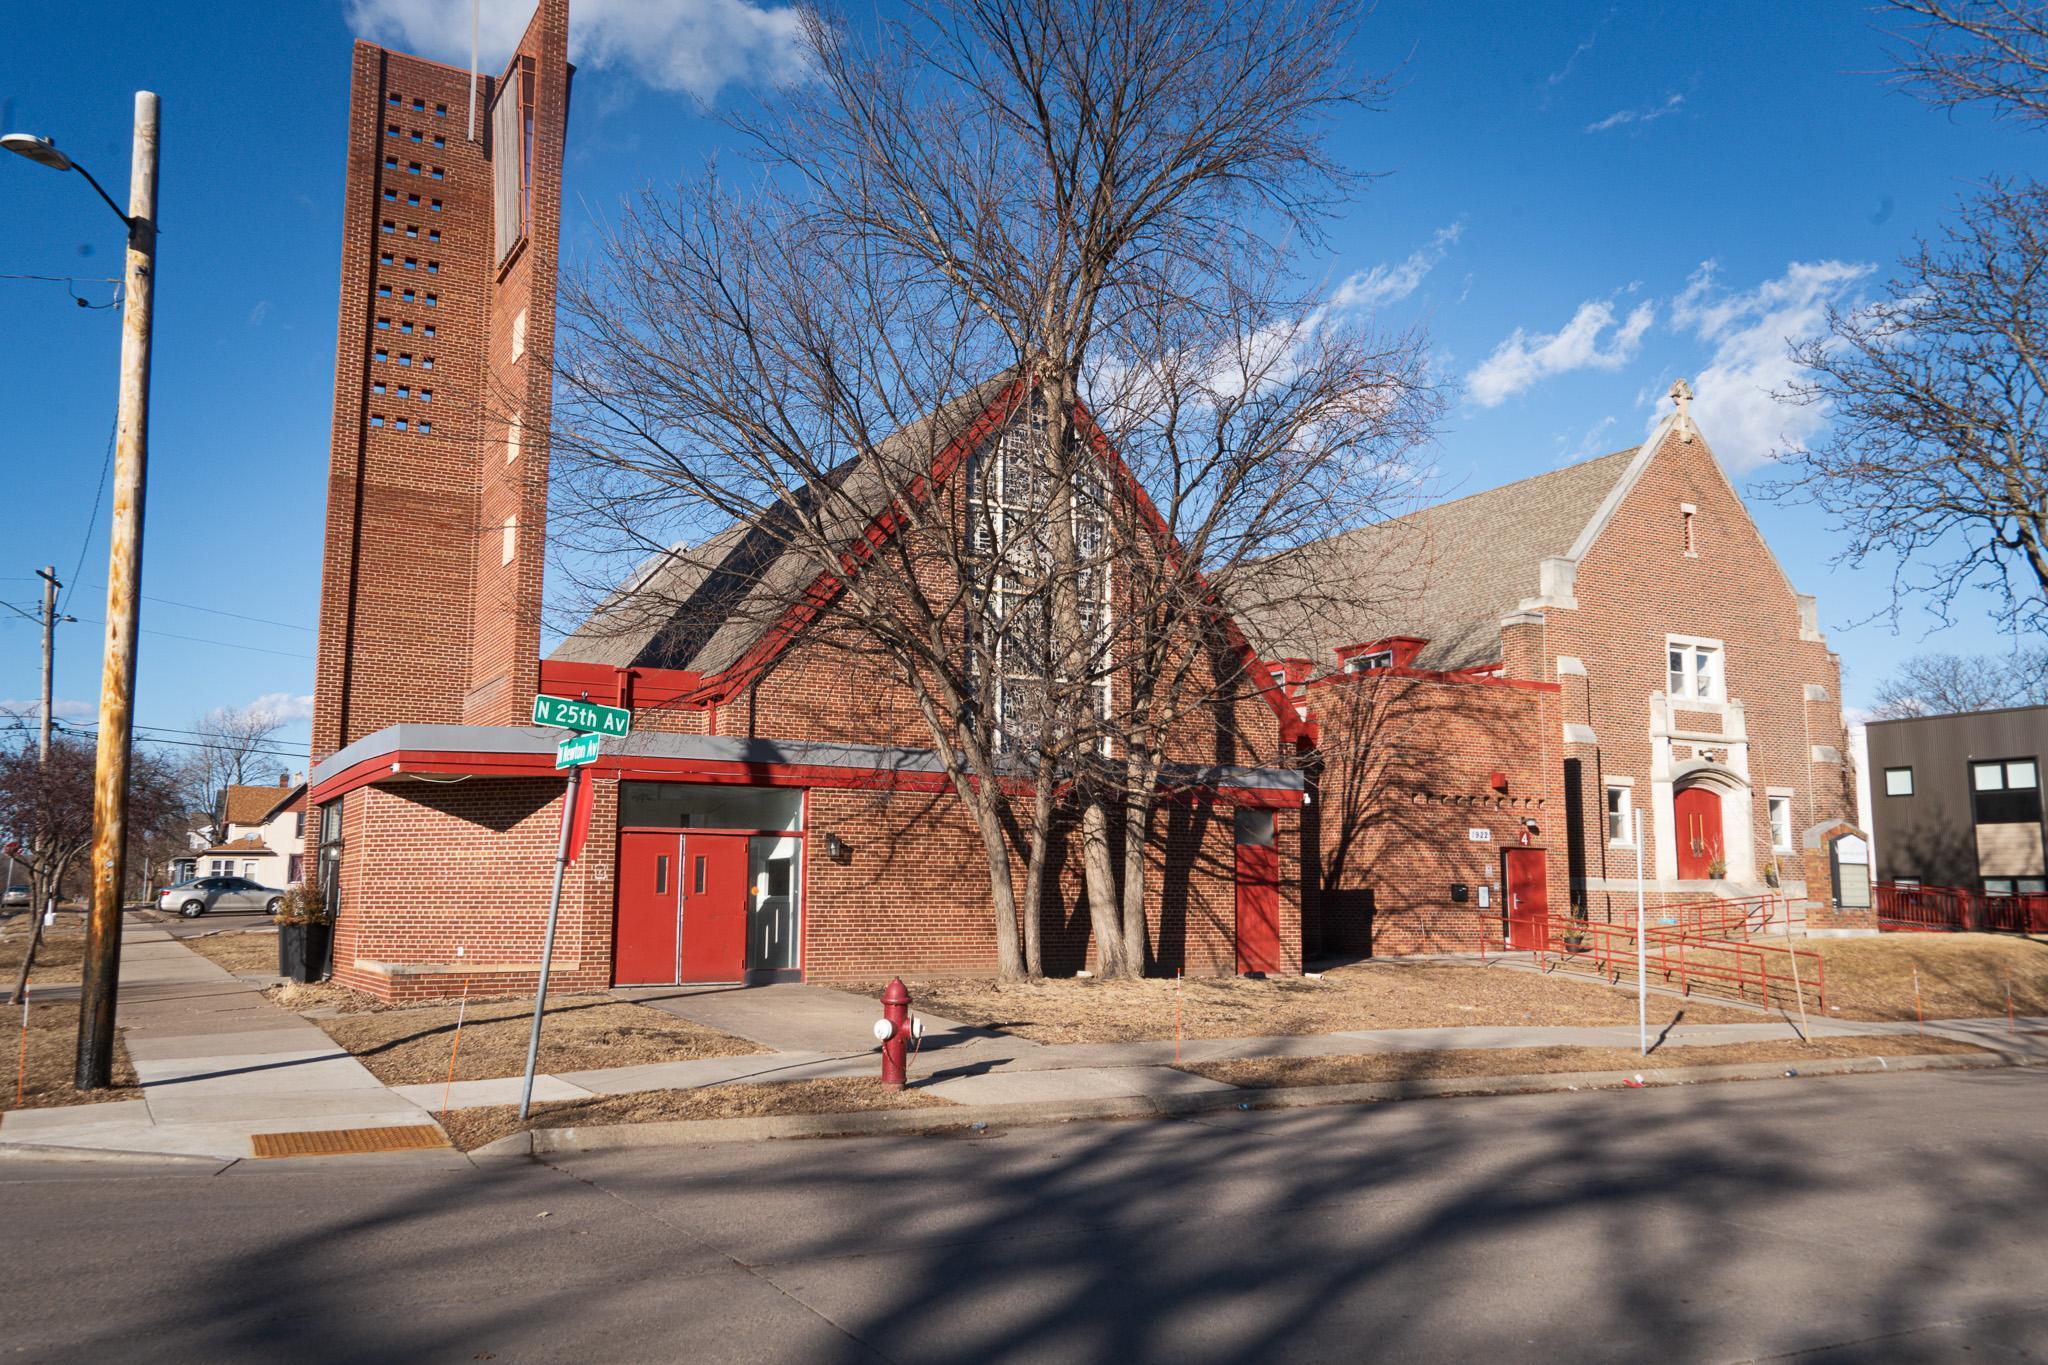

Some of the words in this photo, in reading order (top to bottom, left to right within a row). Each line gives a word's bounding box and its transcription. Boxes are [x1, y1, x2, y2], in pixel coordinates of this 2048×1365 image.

[537, 700, 550, 719] N
[556, 704, 597, 727] 25th
[603, 713, 625, 731] Av
[1521, 833, 1528, 845] 4
